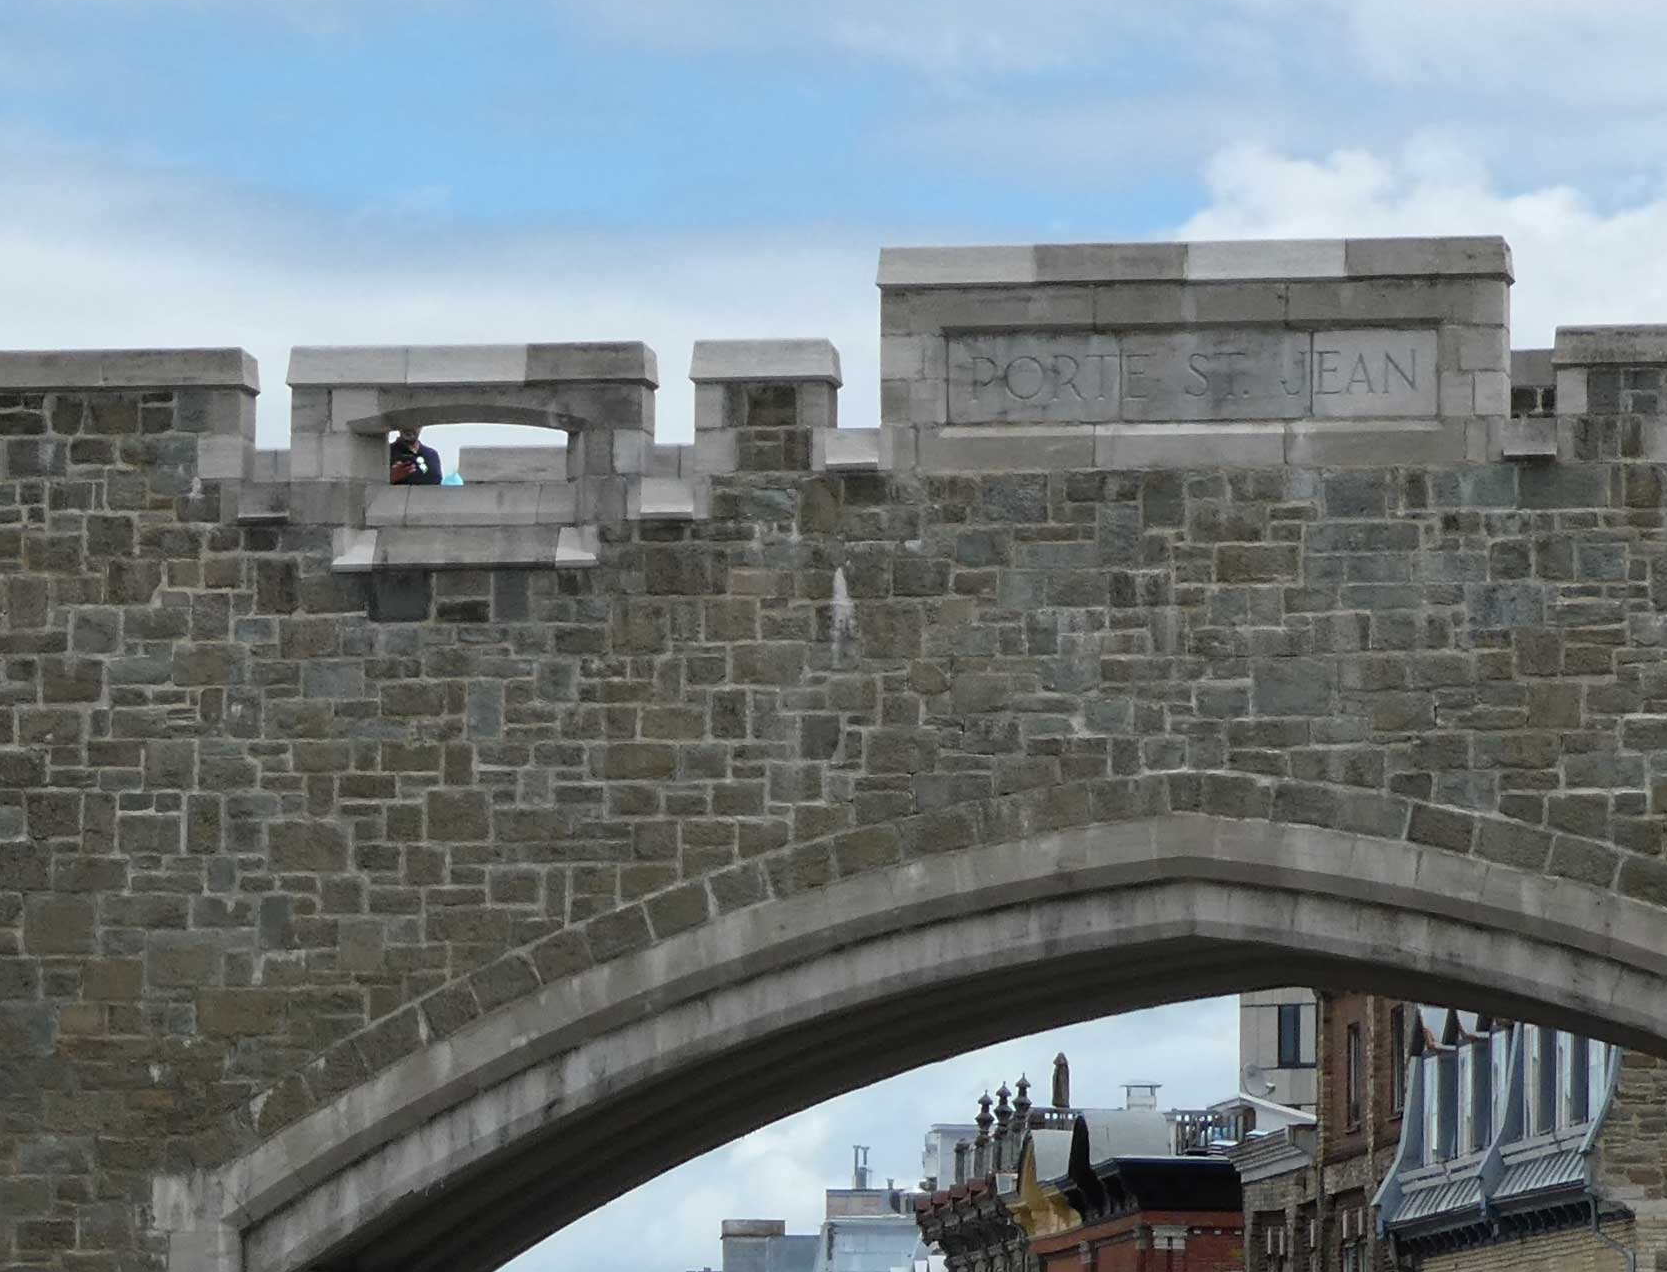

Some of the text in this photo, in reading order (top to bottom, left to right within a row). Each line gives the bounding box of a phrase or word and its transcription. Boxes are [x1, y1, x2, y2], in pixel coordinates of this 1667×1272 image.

[969, 348, 1419, 402] PORTE ST. JEAN
